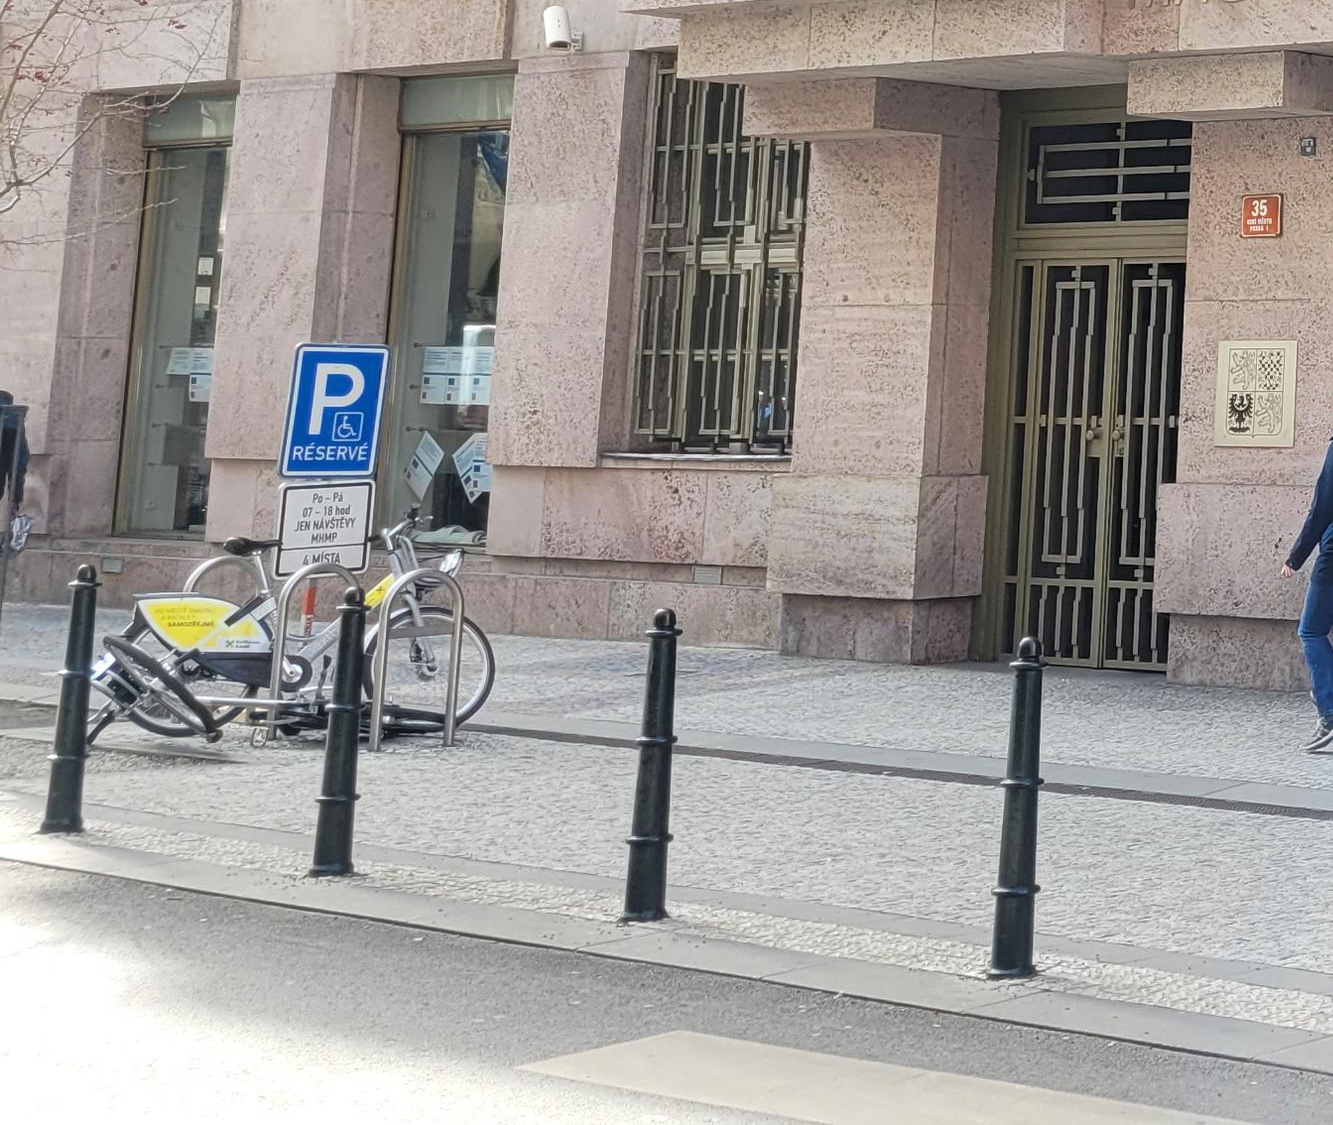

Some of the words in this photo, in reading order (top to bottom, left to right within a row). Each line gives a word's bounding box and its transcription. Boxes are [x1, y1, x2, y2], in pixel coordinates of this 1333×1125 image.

[1251, 199, 1268, 217] 35
[308, 362, 365, 435] P
[292, 442, 368, 461] RÉSERVÉ
[312, 493, 324, 503] Po
[333, 492, 343, 502] Pá
[302, 507, 313, 517] 07
[324, 506, 333, 516] 18
[335, 504, 351, 515] hod
[294, 520, 311, 532] JEN
[312, 516, 356, 530] NÁVŠTĚVY
[311, 532, 338, 544] MHMP
[302, 555, 309, 565] 4
[312, 551, 341, 564] MÍSTA
